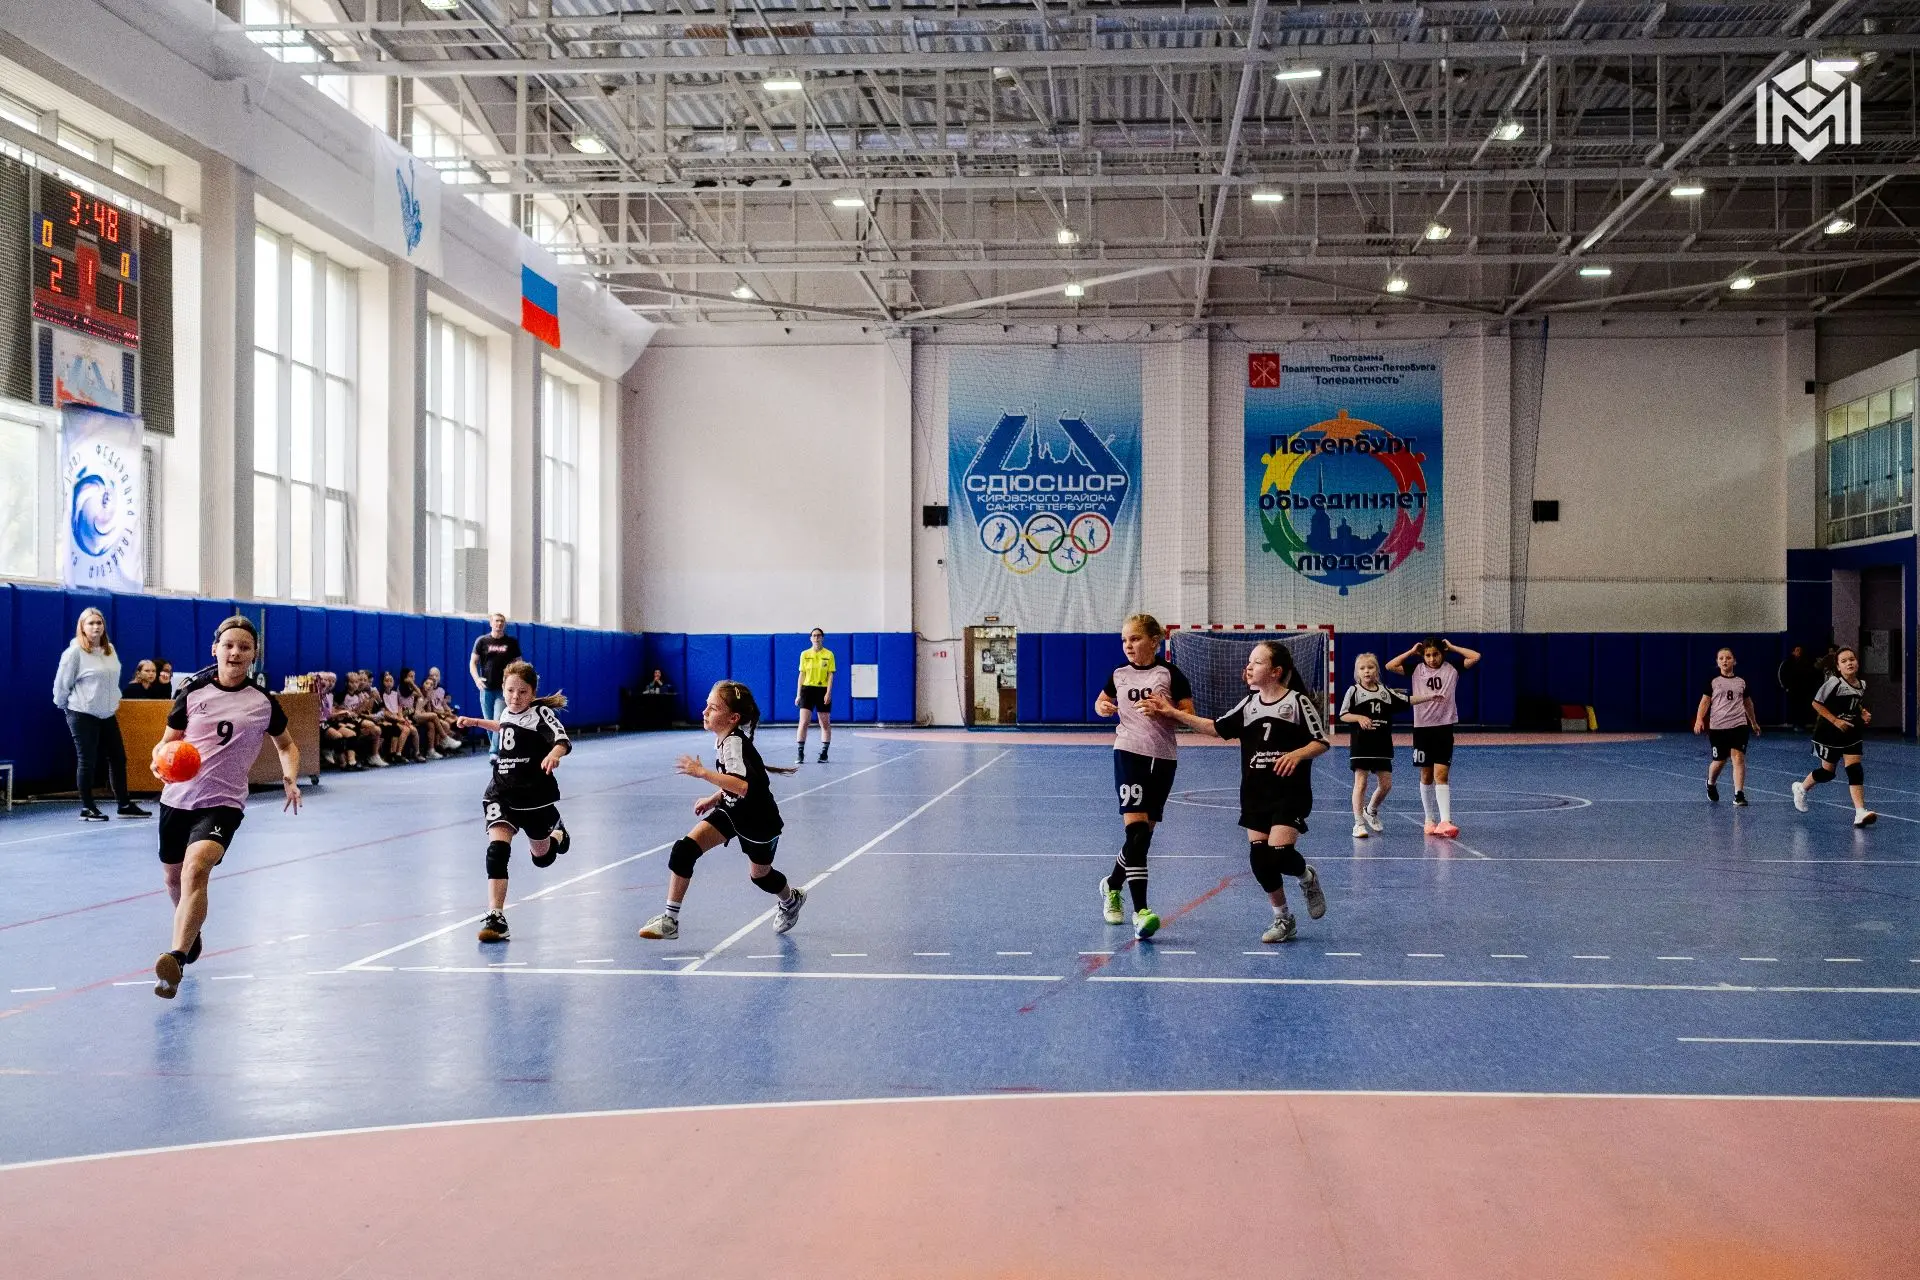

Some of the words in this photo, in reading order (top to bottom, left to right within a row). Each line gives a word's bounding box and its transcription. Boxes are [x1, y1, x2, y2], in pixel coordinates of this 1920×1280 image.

[69, 191, 118, 243] 3:48
[42, 219, 53, 248] 0
[50, 255, 63, 293] 2
[87, 260, 93, 286] 1
[120, 252, 130, 278] 0
[117, 283, 123, 314] 1
[1330, 354, 1384, 362] Программа
[1311, 374, 1405, 386] "Толерантность"
[1269, 433, 1417, 456] Петербург
[966, 475, 1126, 495] СДЮСШОР
[977, 494, 1060, 503] КИРОВСКОГО
[1064, 493, 1116, 502] РАЙОНА
[986, 503, 1106, 511] САНКТ-ПЕТЕРБУРГА
[1299, 551, 1390, 571] людей
[1426, 676, 1443, 691] 40
[1726, 690, 1734, 701] 8
[1370, 701, 1381, 713] 14
[216, 720, 234, 746] 9
[499, 727, 516, 751] 18
[1262, 722, 1272, 741] 7
[1712, 747, 1718, 758] 8
[1119, 784, 1143, 807] 99
